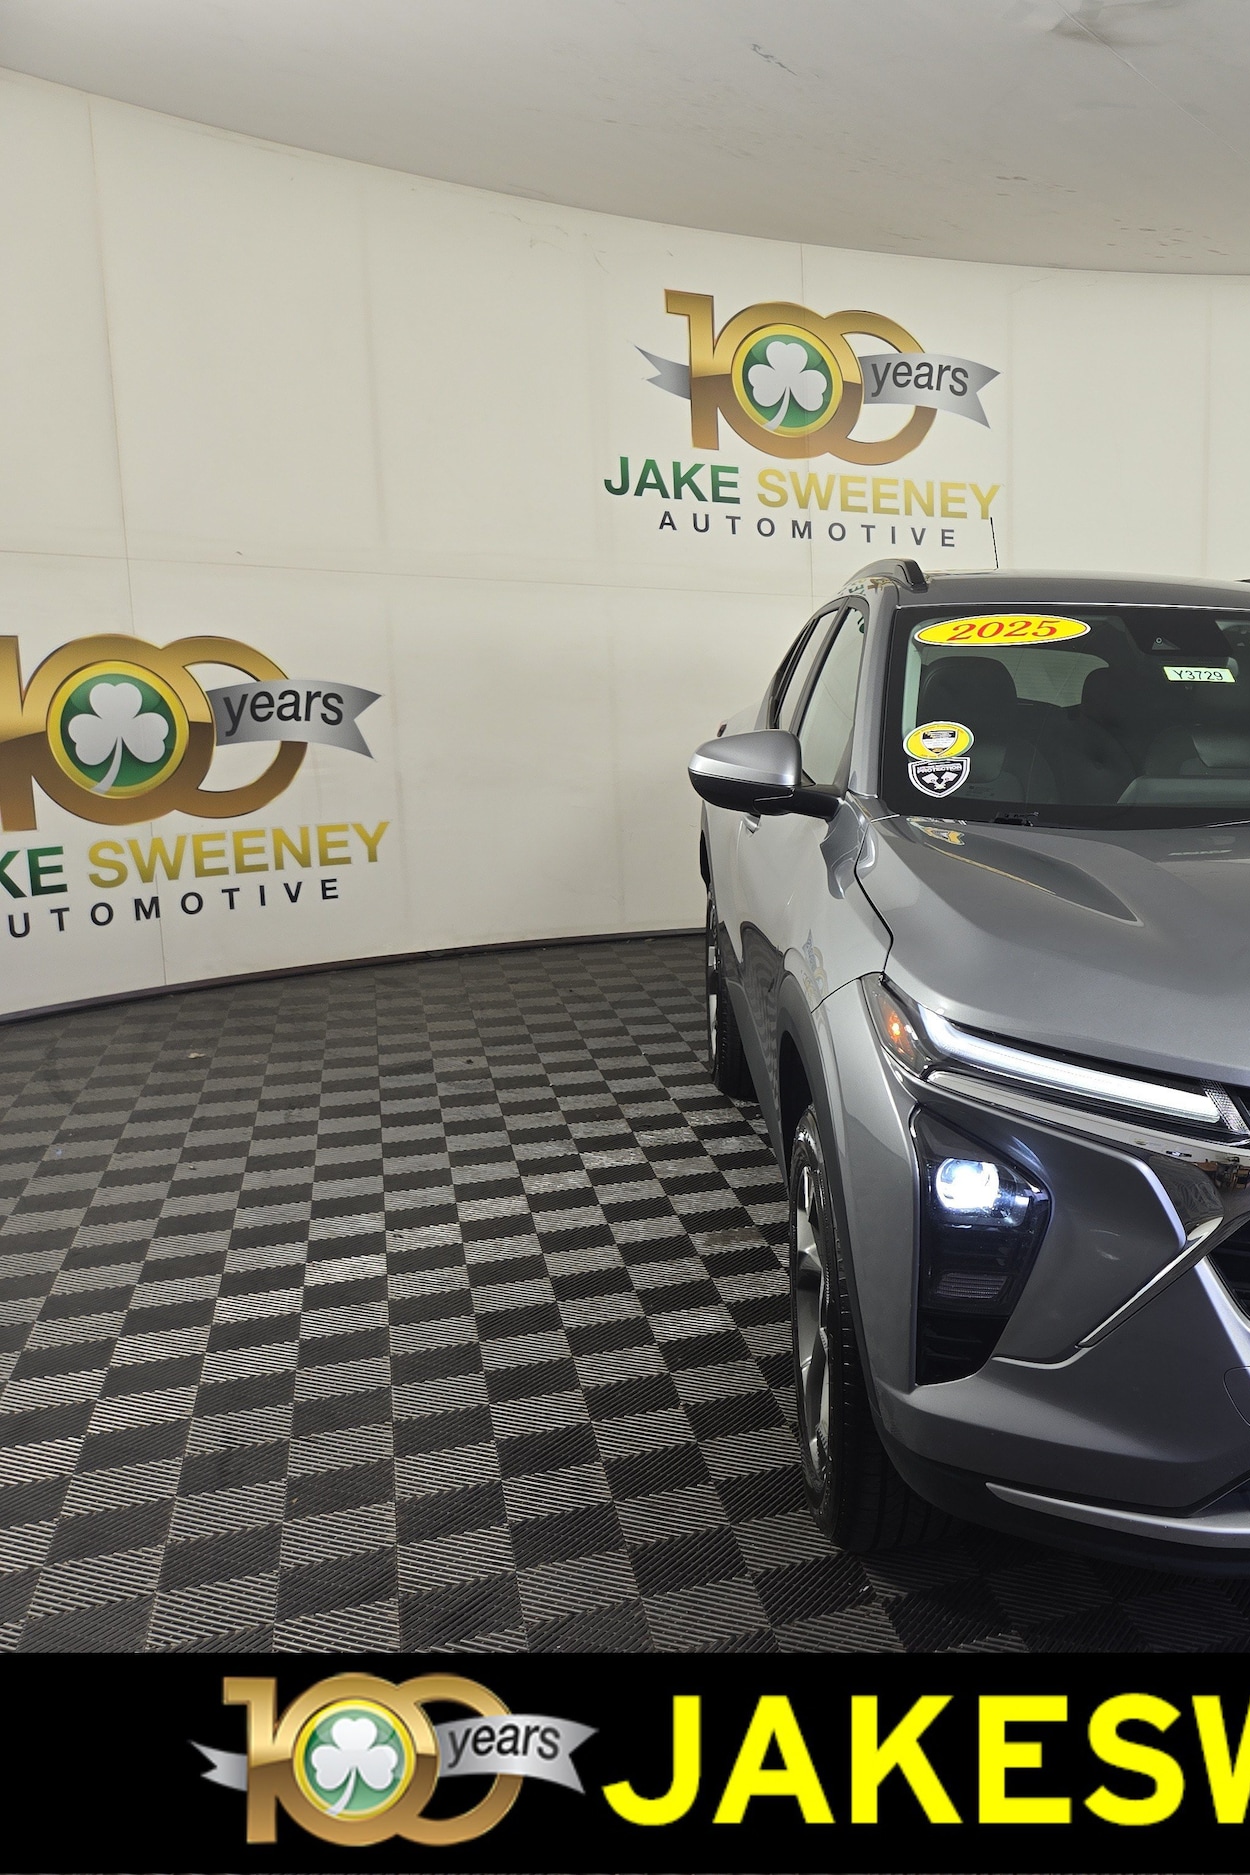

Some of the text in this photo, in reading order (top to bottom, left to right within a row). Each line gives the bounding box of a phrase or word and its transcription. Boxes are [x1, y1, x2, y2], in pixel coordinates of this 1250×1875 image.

[664, 288, 969, 466] 100 years
[603, 456, 1001, 520] JAKE SWEENEY
[658, 510, 956, 548] AUTOMOTIVE
[947, 620, 1060, 641] 2025
[1173, 669, 1224, 681] Y3729
[222, 689, 345, 737] years
[87, 821, 391, 889] SWEENEY
